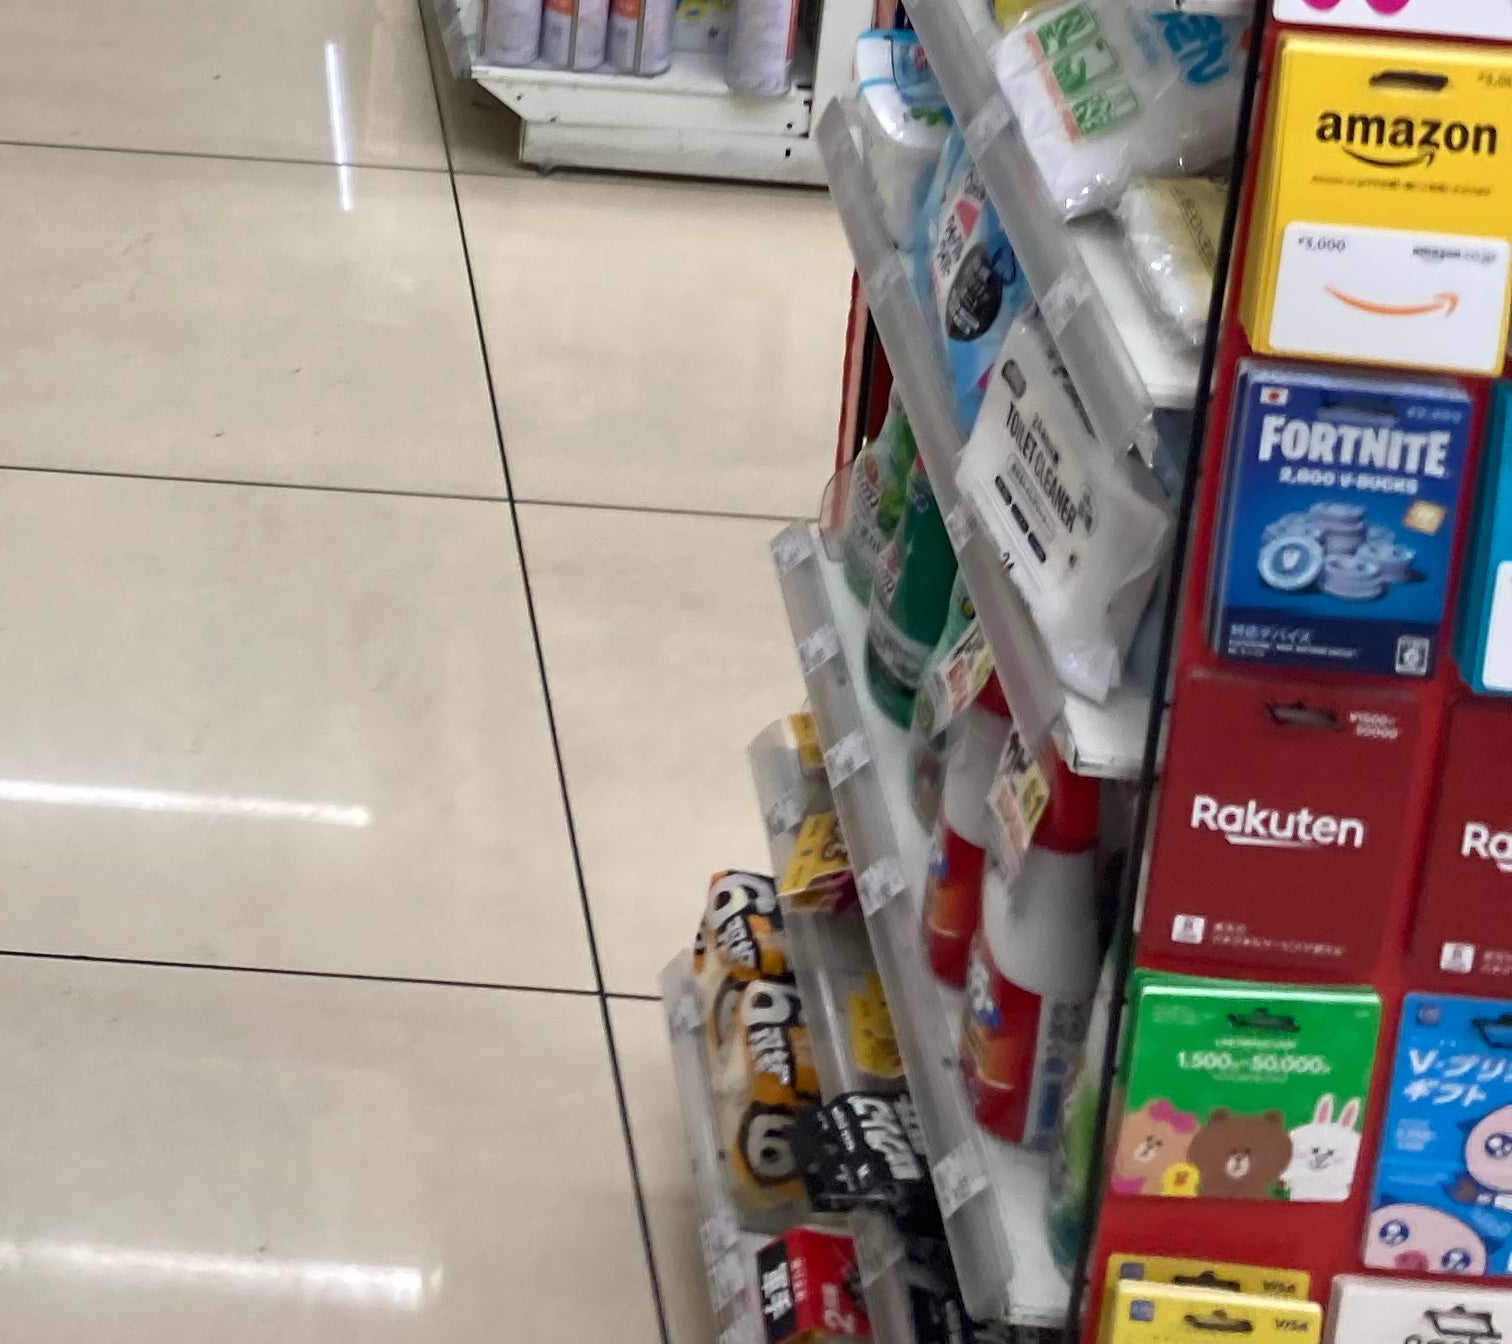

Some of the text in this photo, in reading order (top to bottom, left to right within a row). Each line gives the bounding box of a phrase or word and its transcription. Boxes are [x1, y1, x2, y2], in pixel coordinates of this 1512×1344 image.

[1315, 109, 1499, 157] amazon
[1257, 413, 1452, 479] FORTNITE
[1190, 794, 1365, 849] Rakuten
[1404, 1078, 1487, 1108] ギフト
